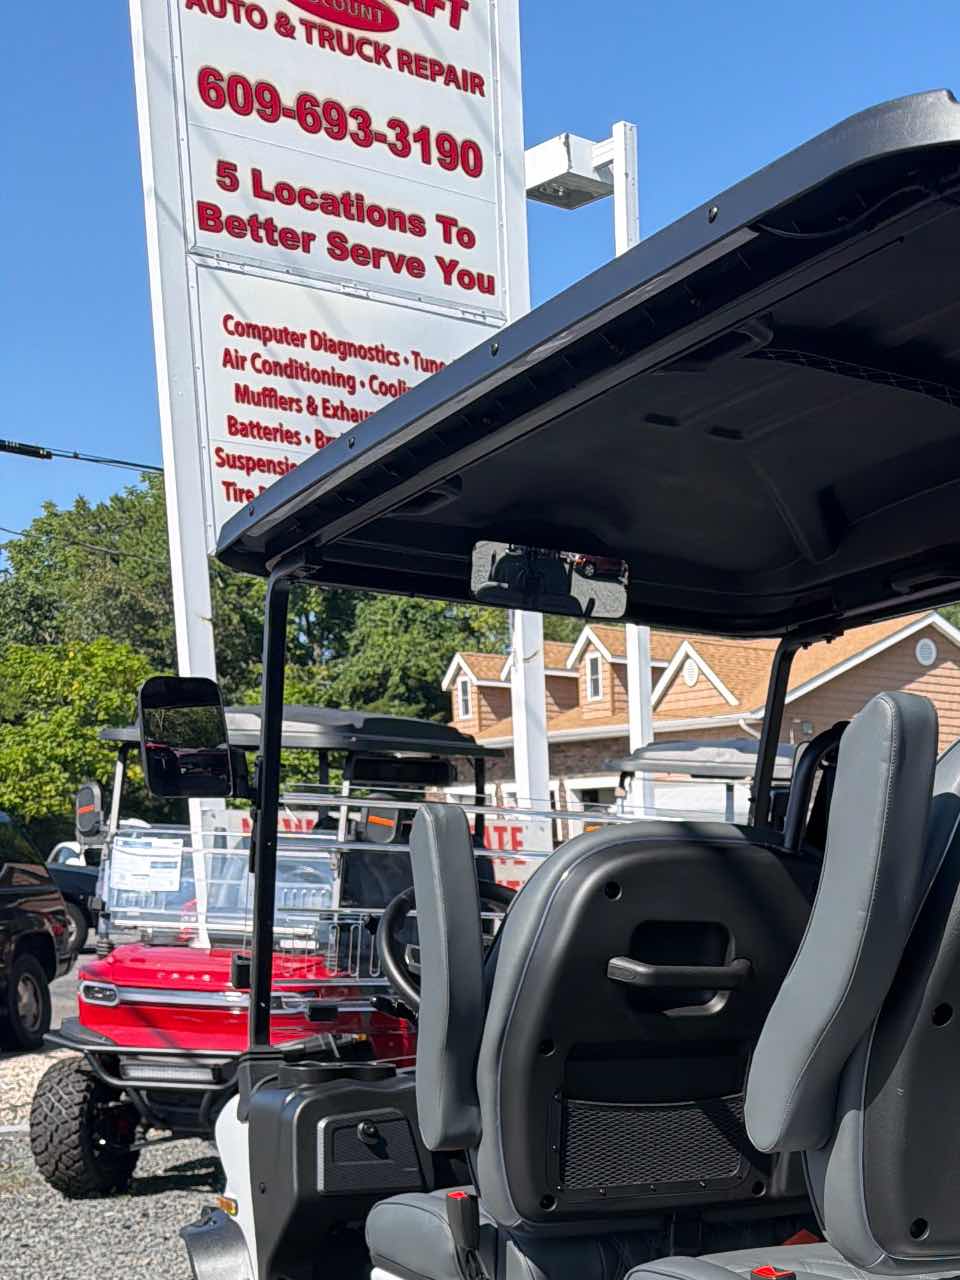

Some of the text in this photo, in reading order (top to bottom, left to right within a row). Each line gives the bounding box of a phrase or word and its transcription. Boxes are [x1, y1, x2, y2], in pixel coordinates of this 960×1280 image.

[274, 11, 296, 40] &
[299, 17, 392, 69] TRUCK
[397, 48, 485, 97] REPAIR
[198, 66, 483, 178] 609-693-3190
[216, 159, 476, 250] 5 Locations To
[197, 200, 495, 296] Better Serve You
[222, 314, 307, 349] Computer
[310, 330, 400, 366] Diagnostics
[222, 348, 246, 371] Air
[251, 353, 356, 395] Conditioning
[234, 383, 376, 423] Mufflers & Exhau
[227, 415, 302, 446] Batteries
[222, 480, 257, 503] Tire
